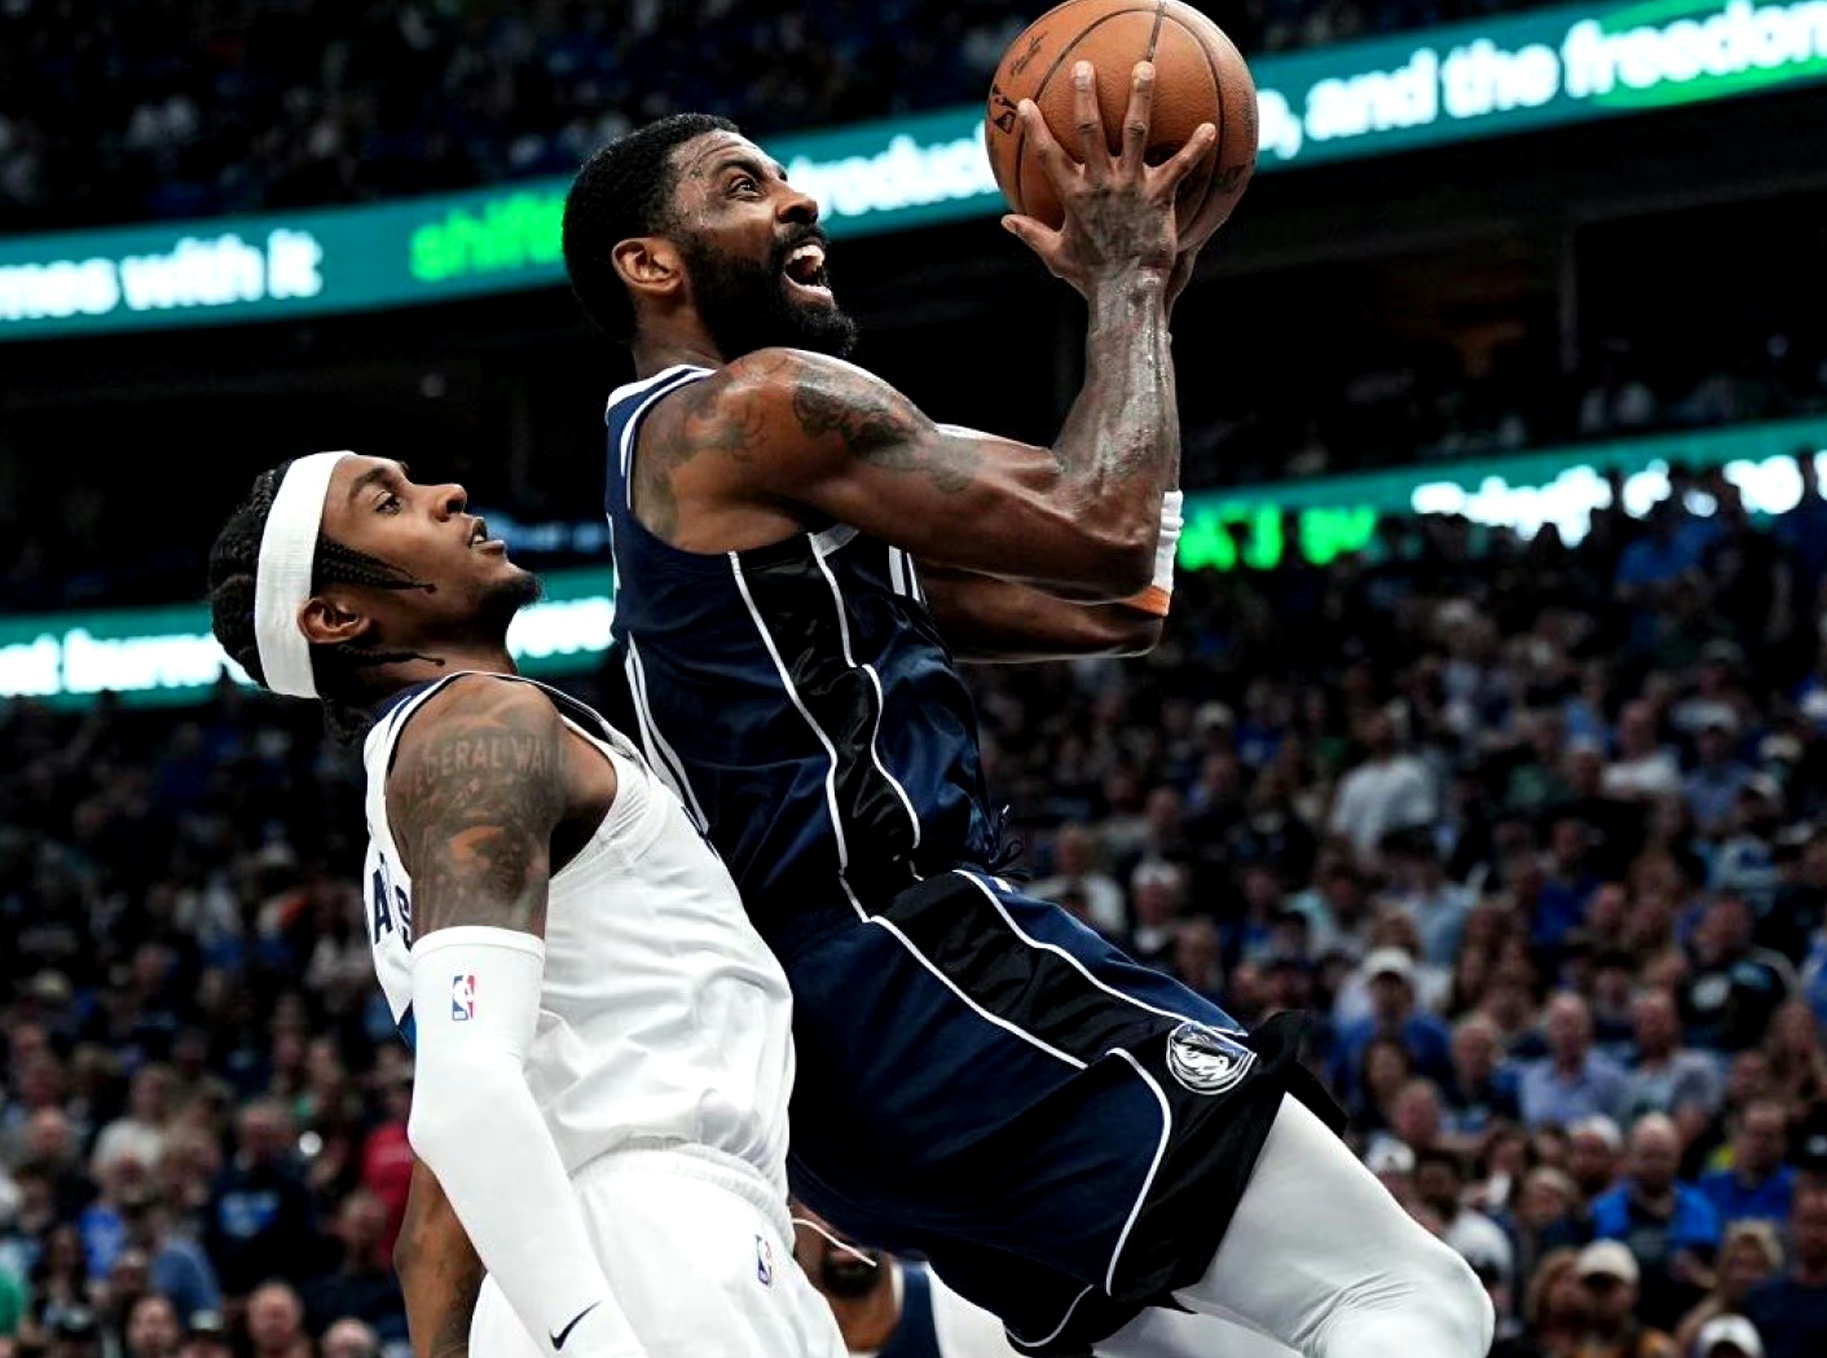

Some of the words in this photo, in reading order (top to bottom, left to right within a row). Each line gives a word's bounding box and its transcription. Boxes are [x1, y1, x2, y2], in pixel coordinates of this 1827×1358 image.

[1305, 80, 1438, 141] and
[1442, 38, 1560, 119] the
[120, 233, 265, 310] with
[268, 228, 323, 299] it
